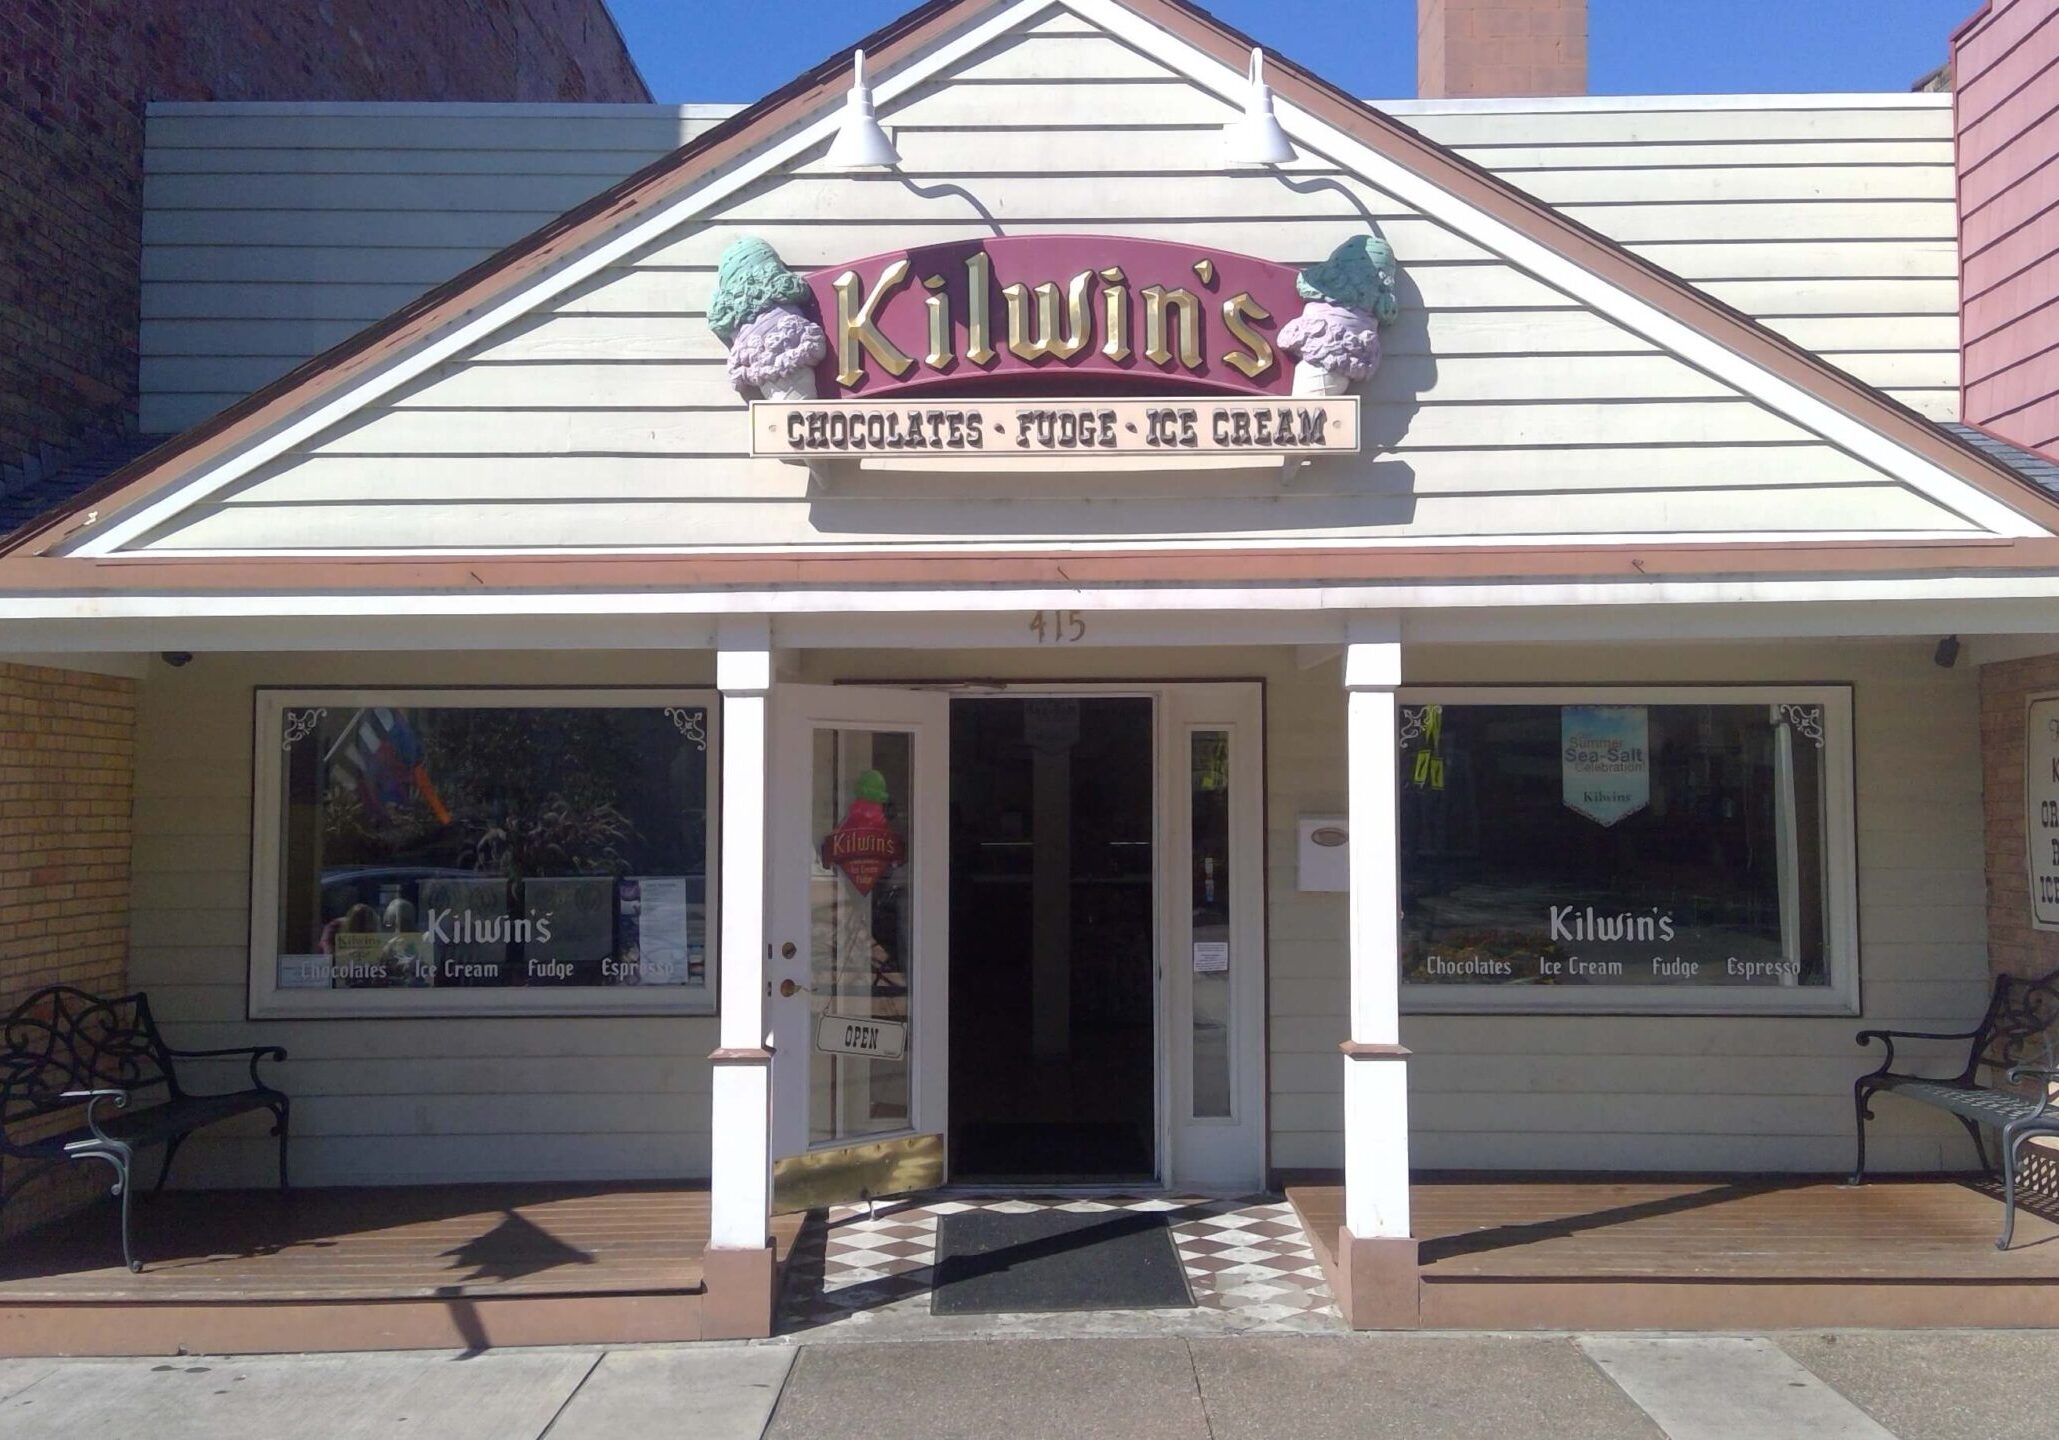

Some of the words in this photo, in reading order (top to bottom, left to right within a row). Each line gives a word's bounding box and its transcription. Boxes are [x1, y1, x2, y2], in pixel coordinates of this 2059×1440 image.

[831, 251, 1276, 388] Kilwin's
[787, 411, 983, 450] CHOCOLATES
[1016, 410, 1116, 449] FUDGE
[1146, 408, 1197, 447] ICE
[1212, 407, 1326, 447] CREAM
[1029, 609, 1086, 643] 415
[1565, 748, 1643, 762] Sea-Salt
[427, 908, 552, 944] Kilwin's
[1550, 905, 1675, 941] Kilwin's
[301, 959, 388, 979] Chocolates
[415, 959, 438, 977] Ice
[445, 959, 498, 978] Cream
[528, 958, 574, 980] Fudge
[602, 957, 674, 981] Espresso
[1427, 956, 1512, 975] Chocolates
[1540, 956, 1561, 975] Ice
[1569, 956, 1622, 975] Cream
[1652, 956, 1699, 978] Fudge
[1727, 956, 1800, 979] Espresso
[845, 1025, 879, 1050] OPEN
